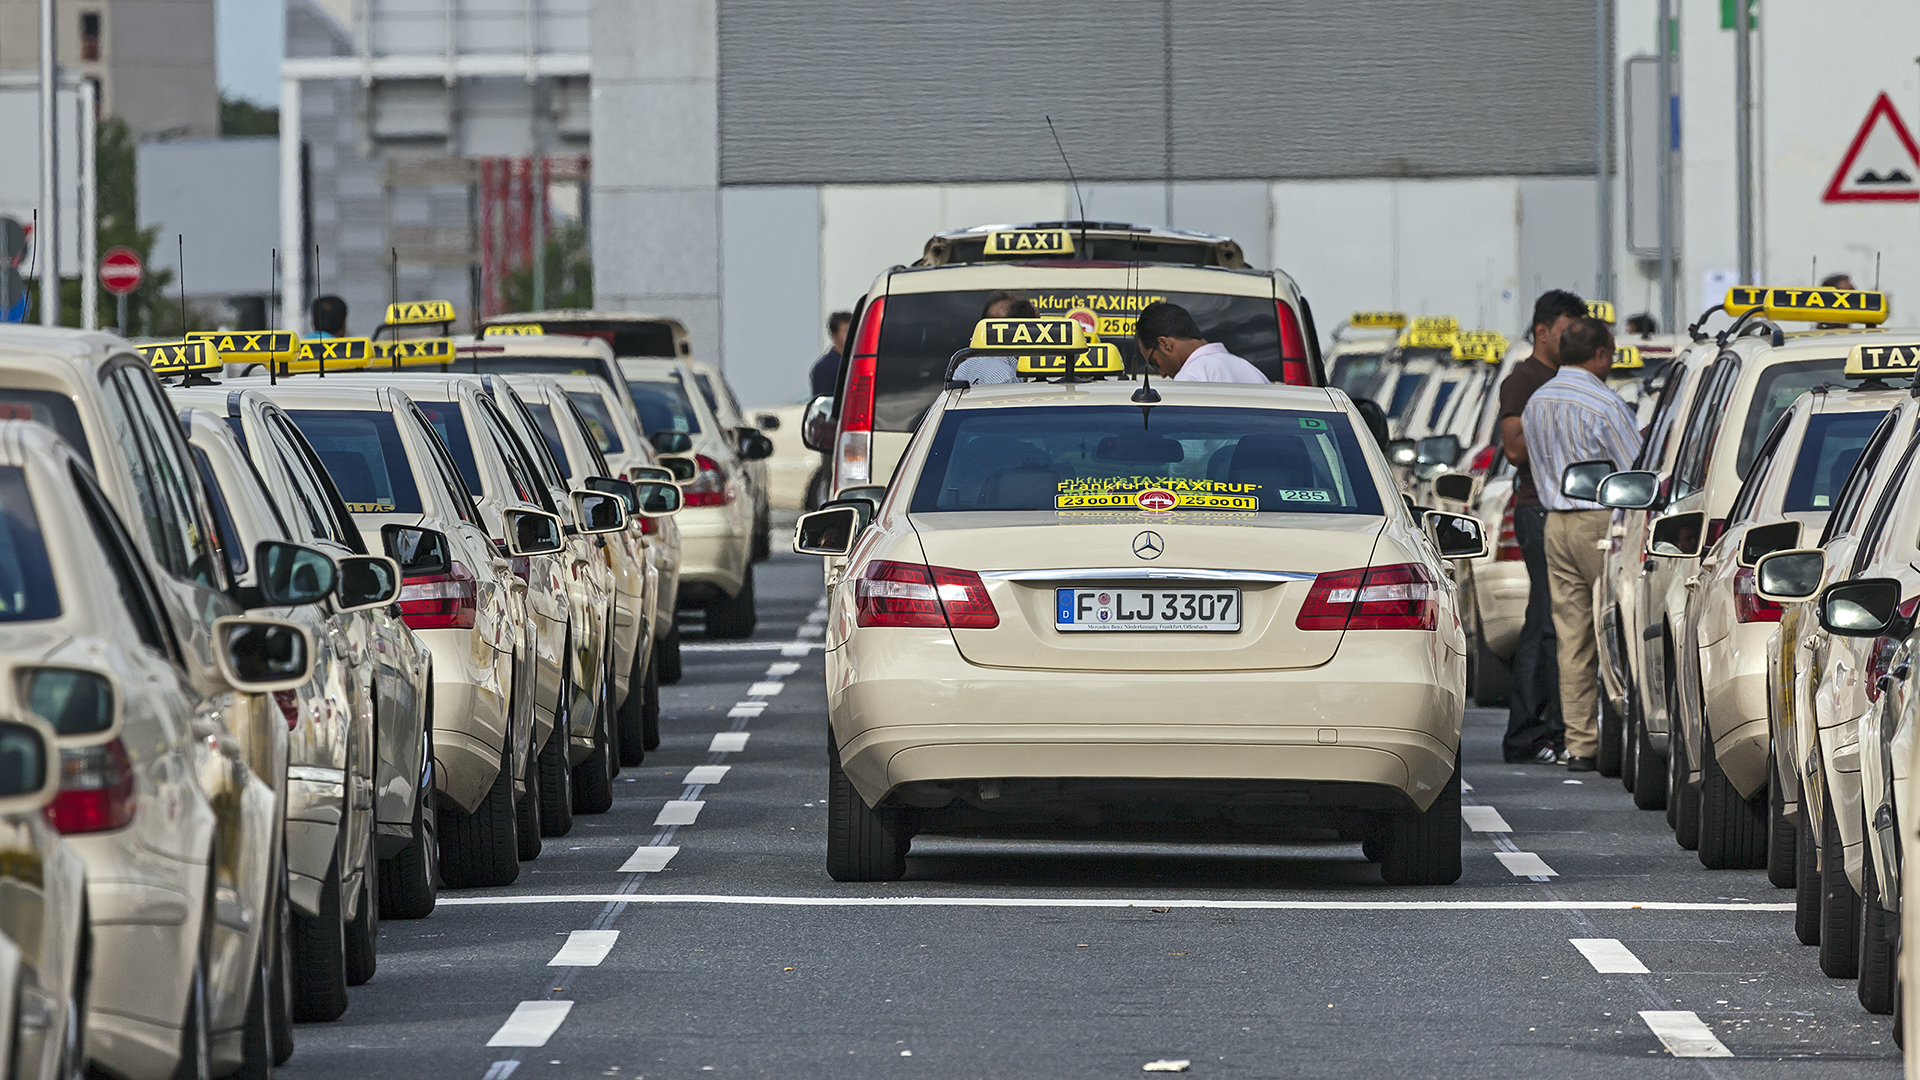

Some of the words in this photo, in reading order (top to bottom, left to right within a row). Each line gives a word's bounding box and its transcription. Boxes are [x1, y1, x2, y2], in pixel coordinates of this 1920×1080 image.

[1000, 233, 1059, 249] TAXI
[1785, 291, 1866, 309] TAXI
[992, 323, 1067, 343] TAXI
[1104, 319, 1120, 332] 25
[299, 341, 352, 359] AXI
[379, 341, 439, 358] TAXI
[1064, 497, 1084, 505] 23
[1112, 496, 1128, 505] 01
[1186, 496, 1206, 505] 25
[1233, 498, 1250, 507] 01
[1284, 490, 1325, 501] 285
[1077, 593, 1095, 620] F
[1116, 593, 1154, 620] LJ
[1161, 594, 1234, 621] 3307
